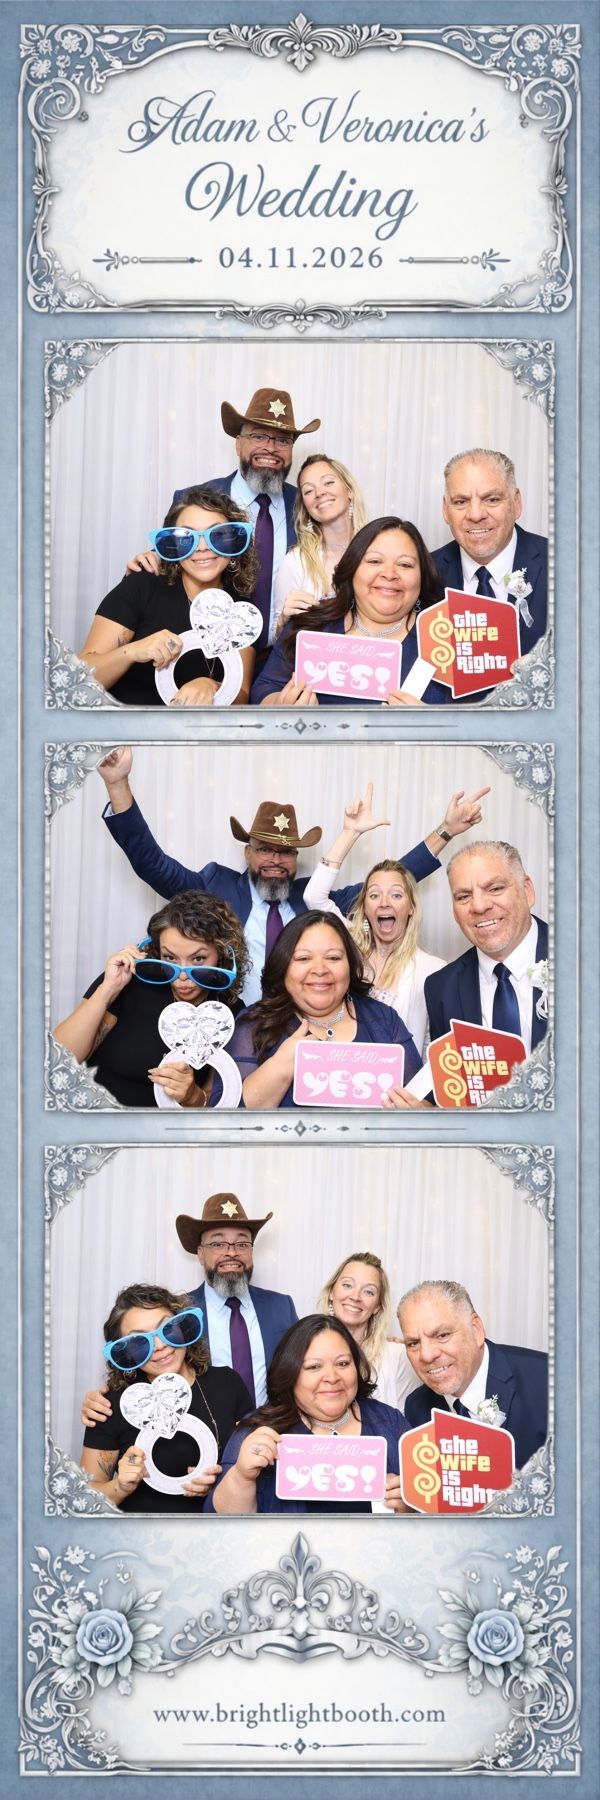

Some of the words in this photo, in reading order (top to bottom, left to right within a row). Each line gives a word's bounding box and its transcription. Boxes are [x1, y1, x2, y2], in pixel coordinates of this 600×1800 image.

[453, 610, 487, 628] the
[326, 641, 347, 654] SHE
[349, 642, 376, 658] SAID
[456, 641, 473, 656] is
[457, 653, 508, 674] Right
[303, 660, 392, 694] YES!
[327, 1050, 348, 1062] SHE
[351, 1051, 378, 1064] SAID
[460, 1043, 496, 1061] the
[467, 1075, 484, 1090] is
[309, 1442, 334, 1456] SHE
[335, 1443, 360, 1457] SAID
[440, 1435, 478, 1455] the
[285, 1463, 377, 1493] YES!
[442, 1470, 461, 1486] is
